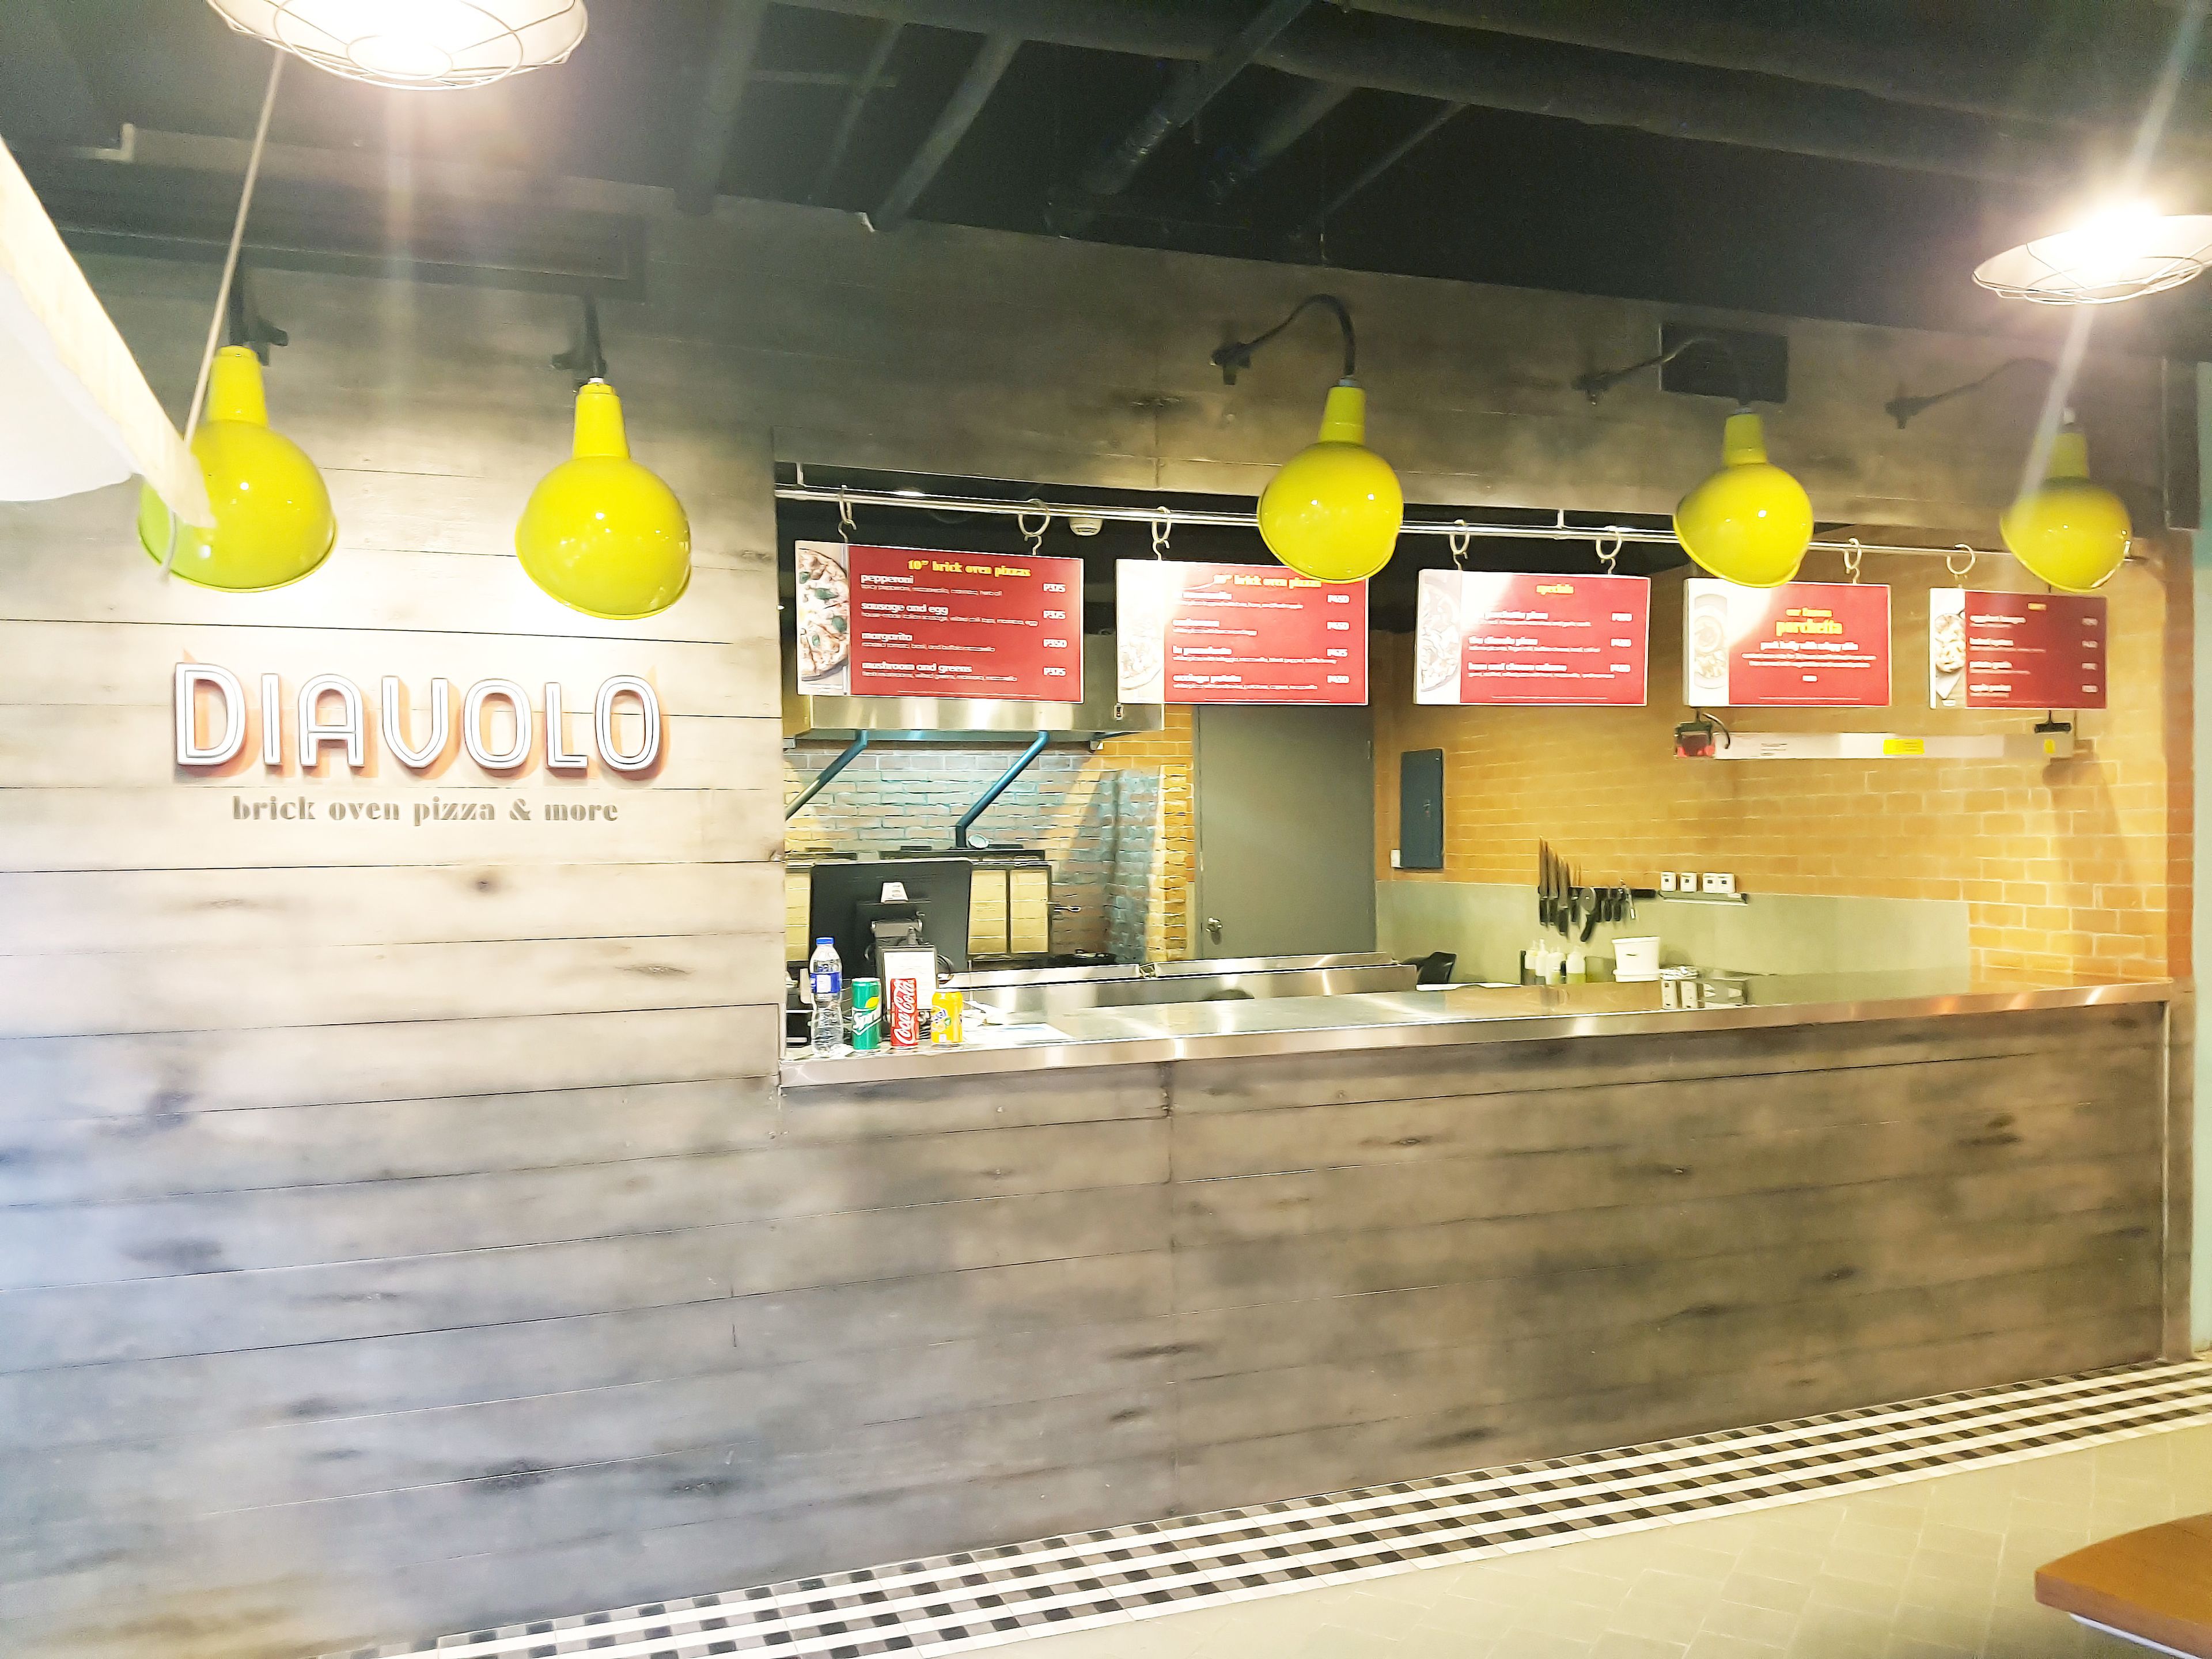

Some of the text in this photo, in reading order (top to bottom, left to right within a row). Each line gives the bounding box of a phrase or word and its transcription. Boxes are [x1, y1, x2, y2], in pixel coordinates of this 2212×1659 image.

[932, 560, 963, 573] brick
[965, 565, 992, 574] oven
[861, 574, 914, 584] pepperoni
[861, 603, 949, 615] sausage and egg
[862, 661, 972, 673] mushroom and greens
[175, 662, 661, 771] DIAVOLO
[233, 796, 619, 826] brick oven pizza & more
[853, 1009, 881, 1031] Spri
[893, 979, 915, 1044] Coca-Cola
